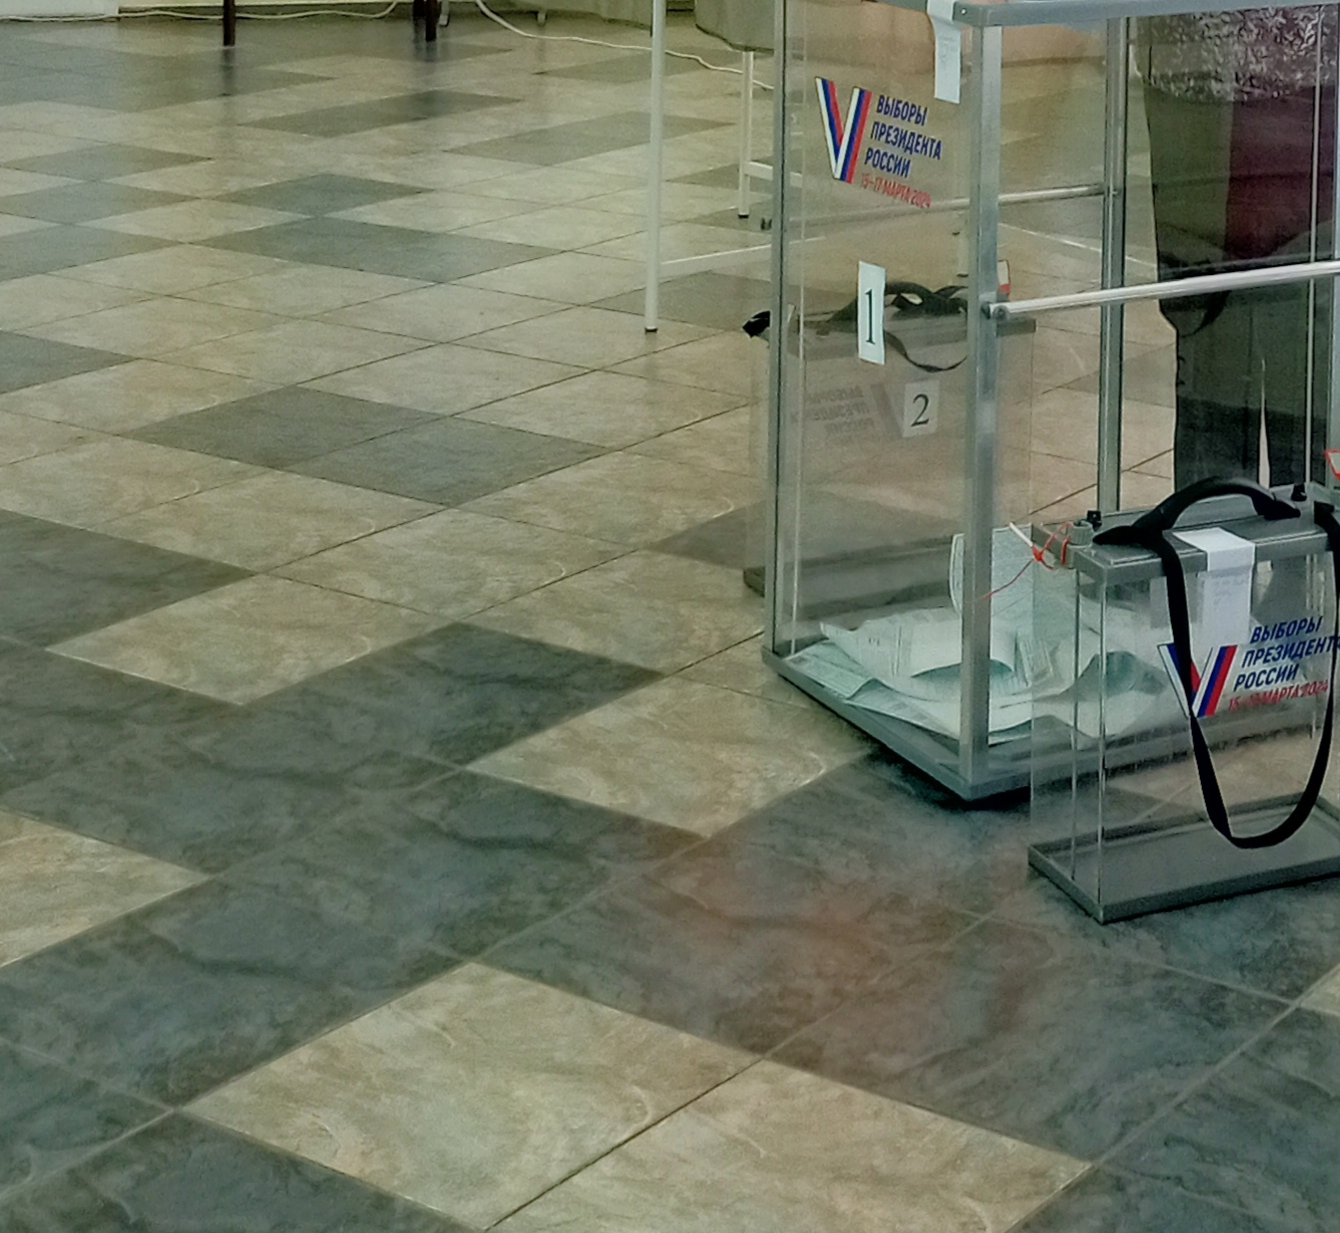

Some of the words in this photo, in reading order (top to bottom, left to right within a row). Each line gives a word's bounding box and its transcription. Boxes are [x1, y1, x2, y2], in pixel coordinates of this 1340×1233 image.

[876, 95, 928, 126] ВЫБОРЫ
[870, 121, 942, 160] ПРЕЗИДЕНТА
[864, 147, 911, 178] РОССИИ
[865, 288, 876, 345] 1
[911, 393, 930, 427] 2
[1250, 616, 1323, 644] ВЫБОРЫ
[1233, 663, 1299, 692] РОССИИ
[1262, 684, 1300, 705] МАРТА
